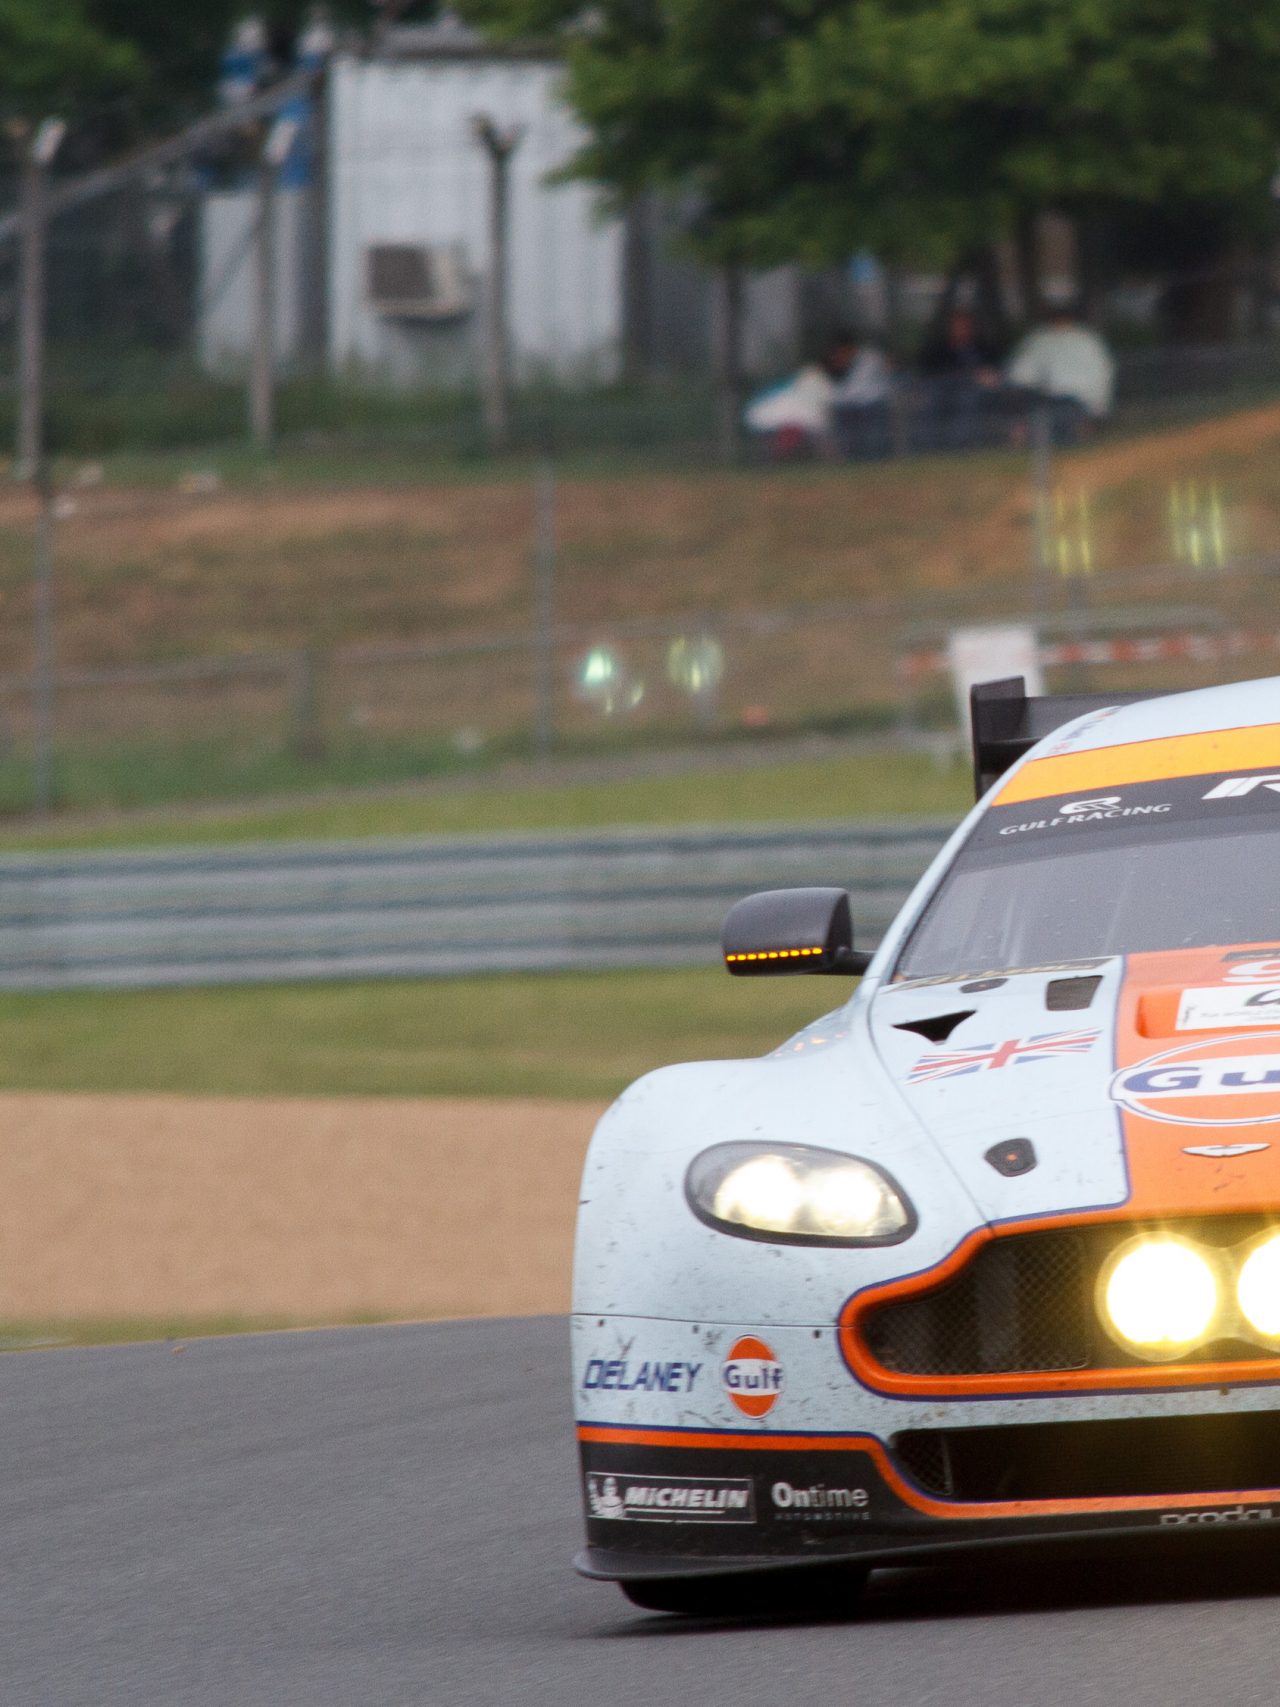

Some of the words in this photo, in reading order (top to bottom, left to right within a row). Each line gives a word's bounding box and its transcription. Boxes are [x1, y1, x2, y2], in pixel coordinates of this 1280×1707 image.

[999, 817, 1065, 835] GULF
[1067, 803, 1173, 824] RACING
[582, 1359, 704, 1392] DELANEY
[724, 1363, 784, 1390] Gulf
[624, 1486, 749, 1508] MICHELIN
[771, 1482, 869, 1508] Ontime
